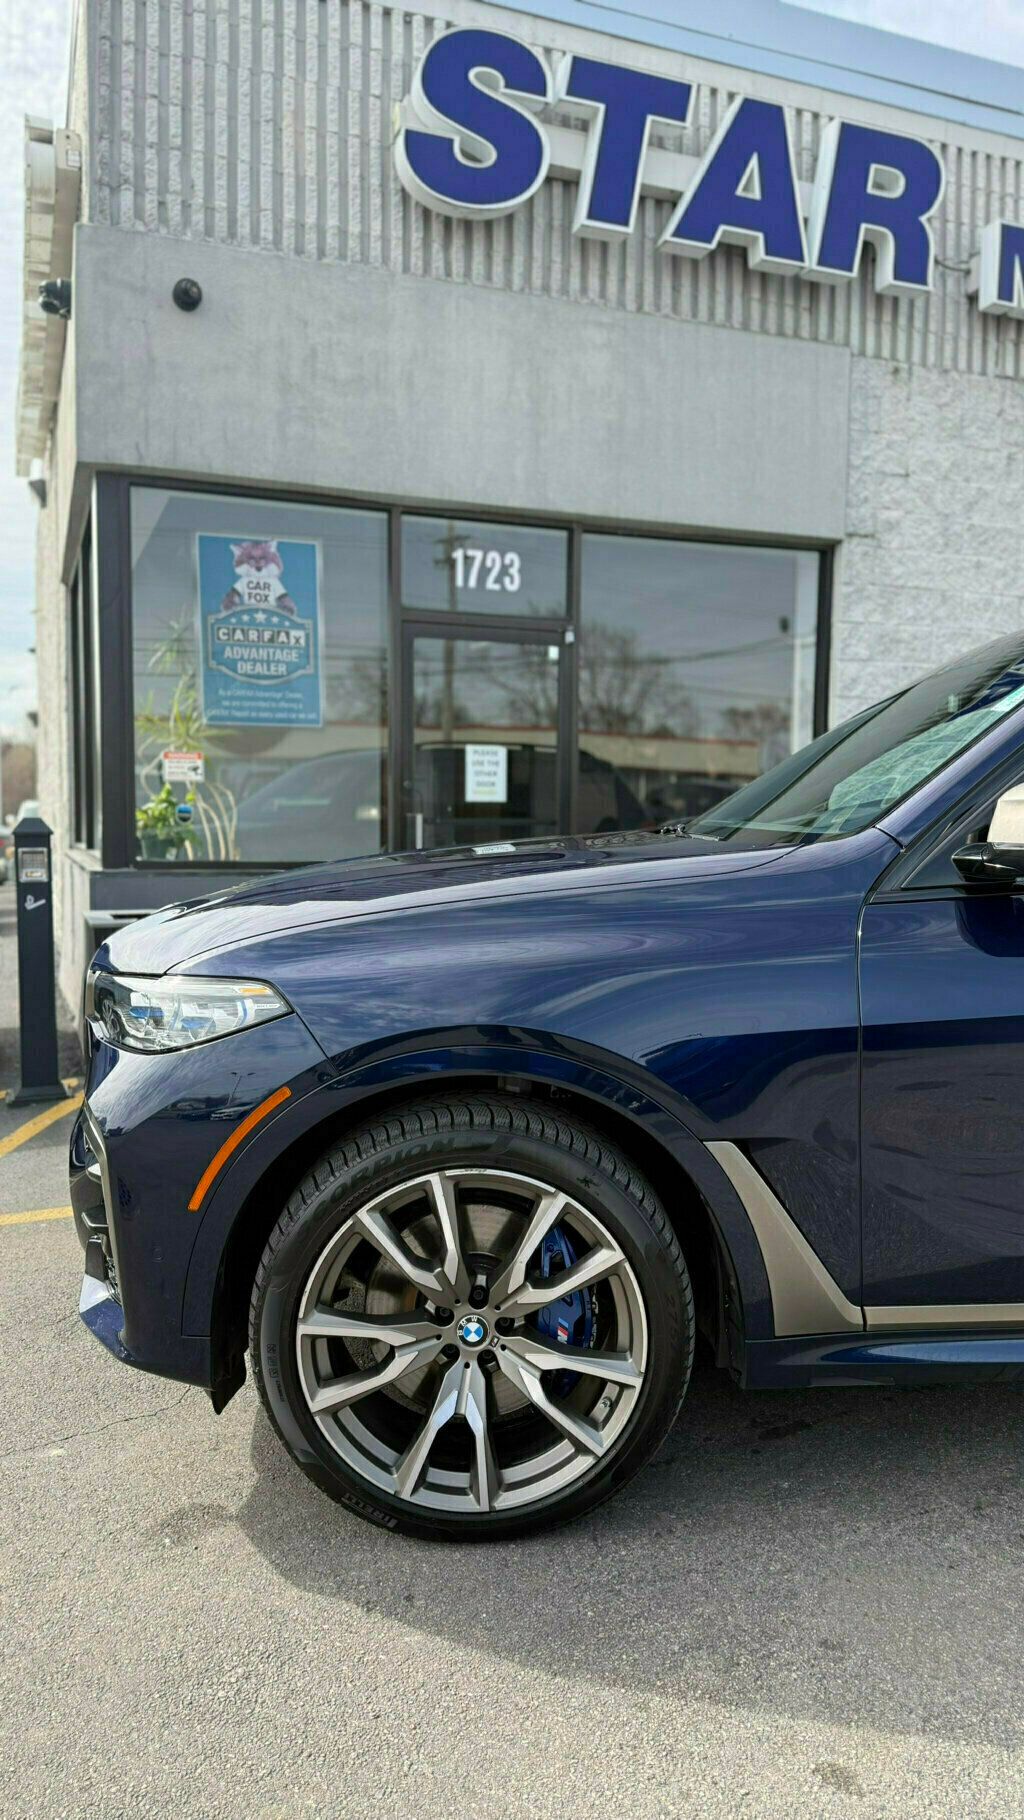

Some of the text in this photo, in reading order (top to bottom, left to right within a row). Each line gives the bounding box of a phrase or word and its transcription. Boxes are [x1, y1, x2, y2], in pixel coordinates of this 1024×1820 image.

[400, 27, 945, 292] STAR
[451, 548, 521, 592] 1723
[246, 580, 271, 592] CAR
[247, 592, 270, 604] FOX
[217, 626, 305, 646] CARFAX
[224, 646, 300, 662] ADVANTAGE
[237, 661, 287, 676] DEALER
